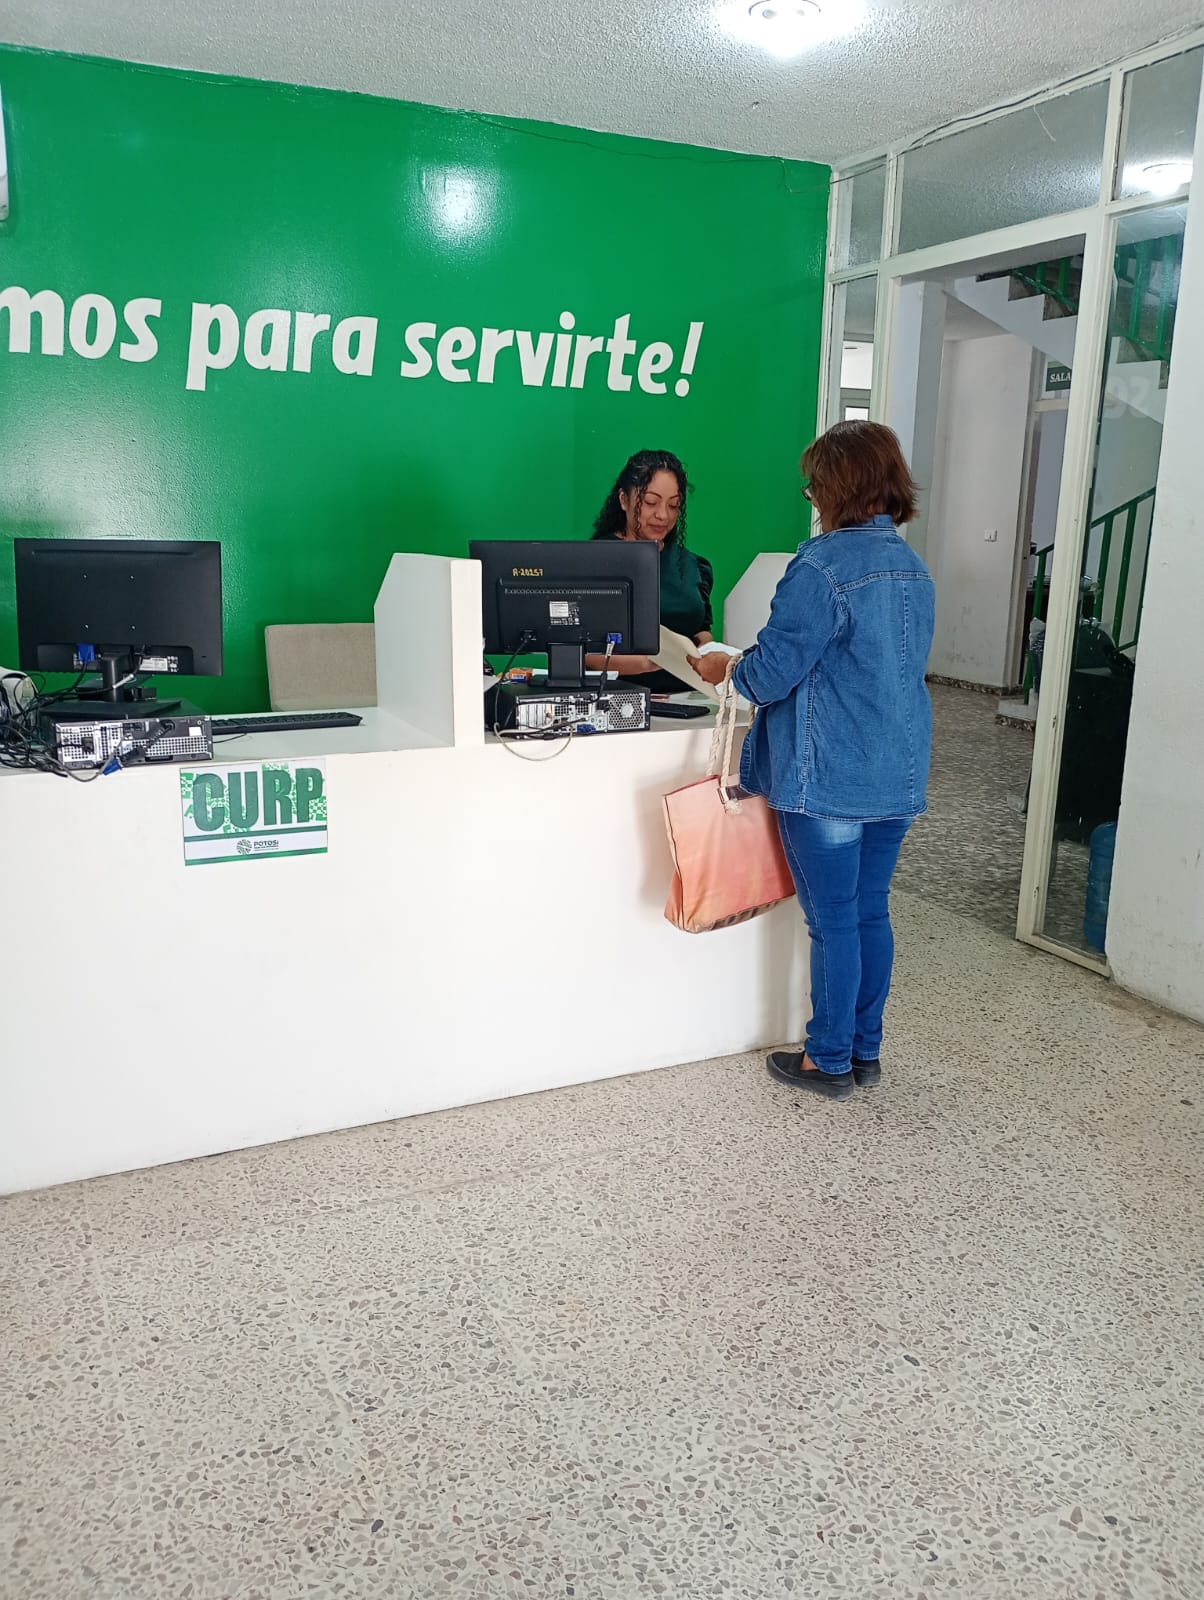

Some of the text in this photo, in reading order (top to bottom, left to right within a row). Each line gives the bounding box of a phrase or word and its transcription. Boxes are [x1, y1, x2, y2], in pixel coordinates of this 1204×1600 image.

[185, 302, 378, 391] para
[400, 311, 704, 397] servirte!
[192, 767, 324, 832] CURP
